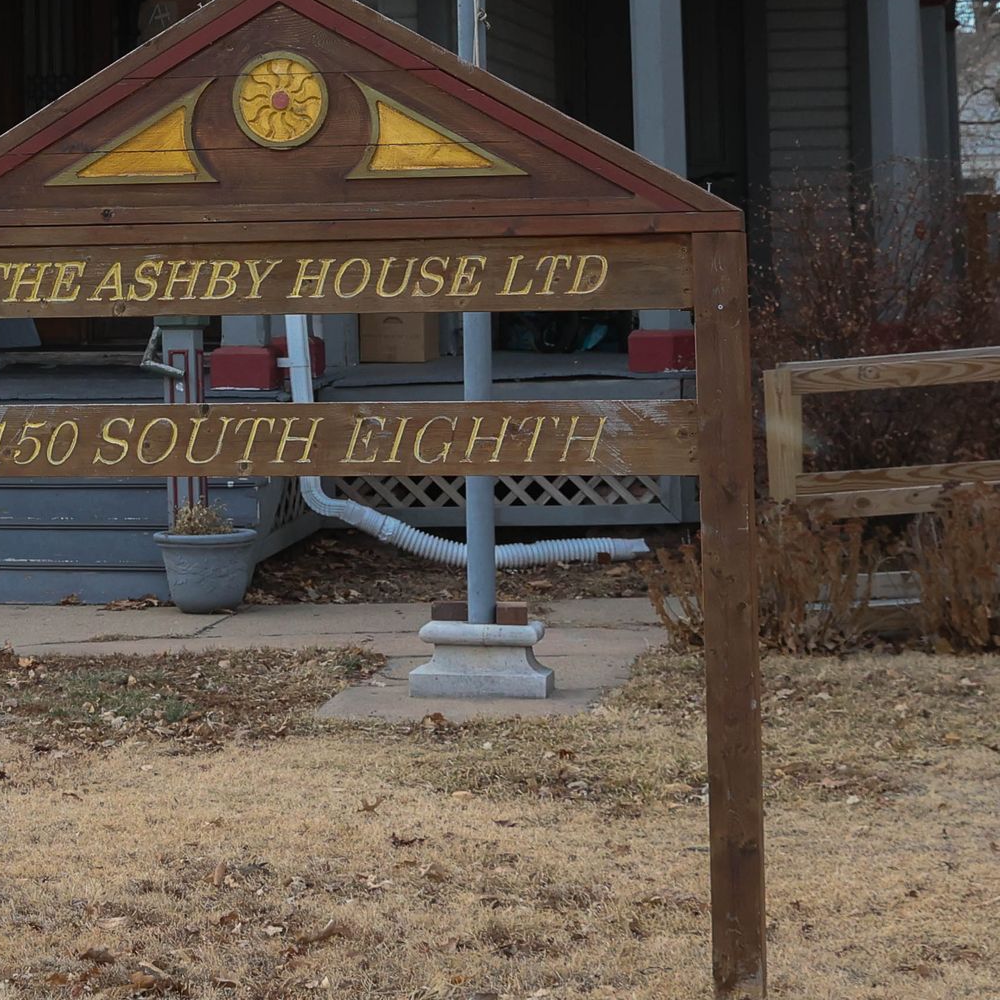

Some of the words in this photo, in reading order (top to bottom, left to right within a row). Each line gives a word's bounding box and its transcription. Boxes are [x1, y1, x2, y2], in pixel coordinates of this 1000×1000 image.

[86, 259, 283, 301] ASHBY
[286, 255, 488, 299] HOUSE
[495, 254, 609, 297] LTD
[92, 416, 325, 465] SOUTH
[339, 415, 608, 464] EIGHTH
